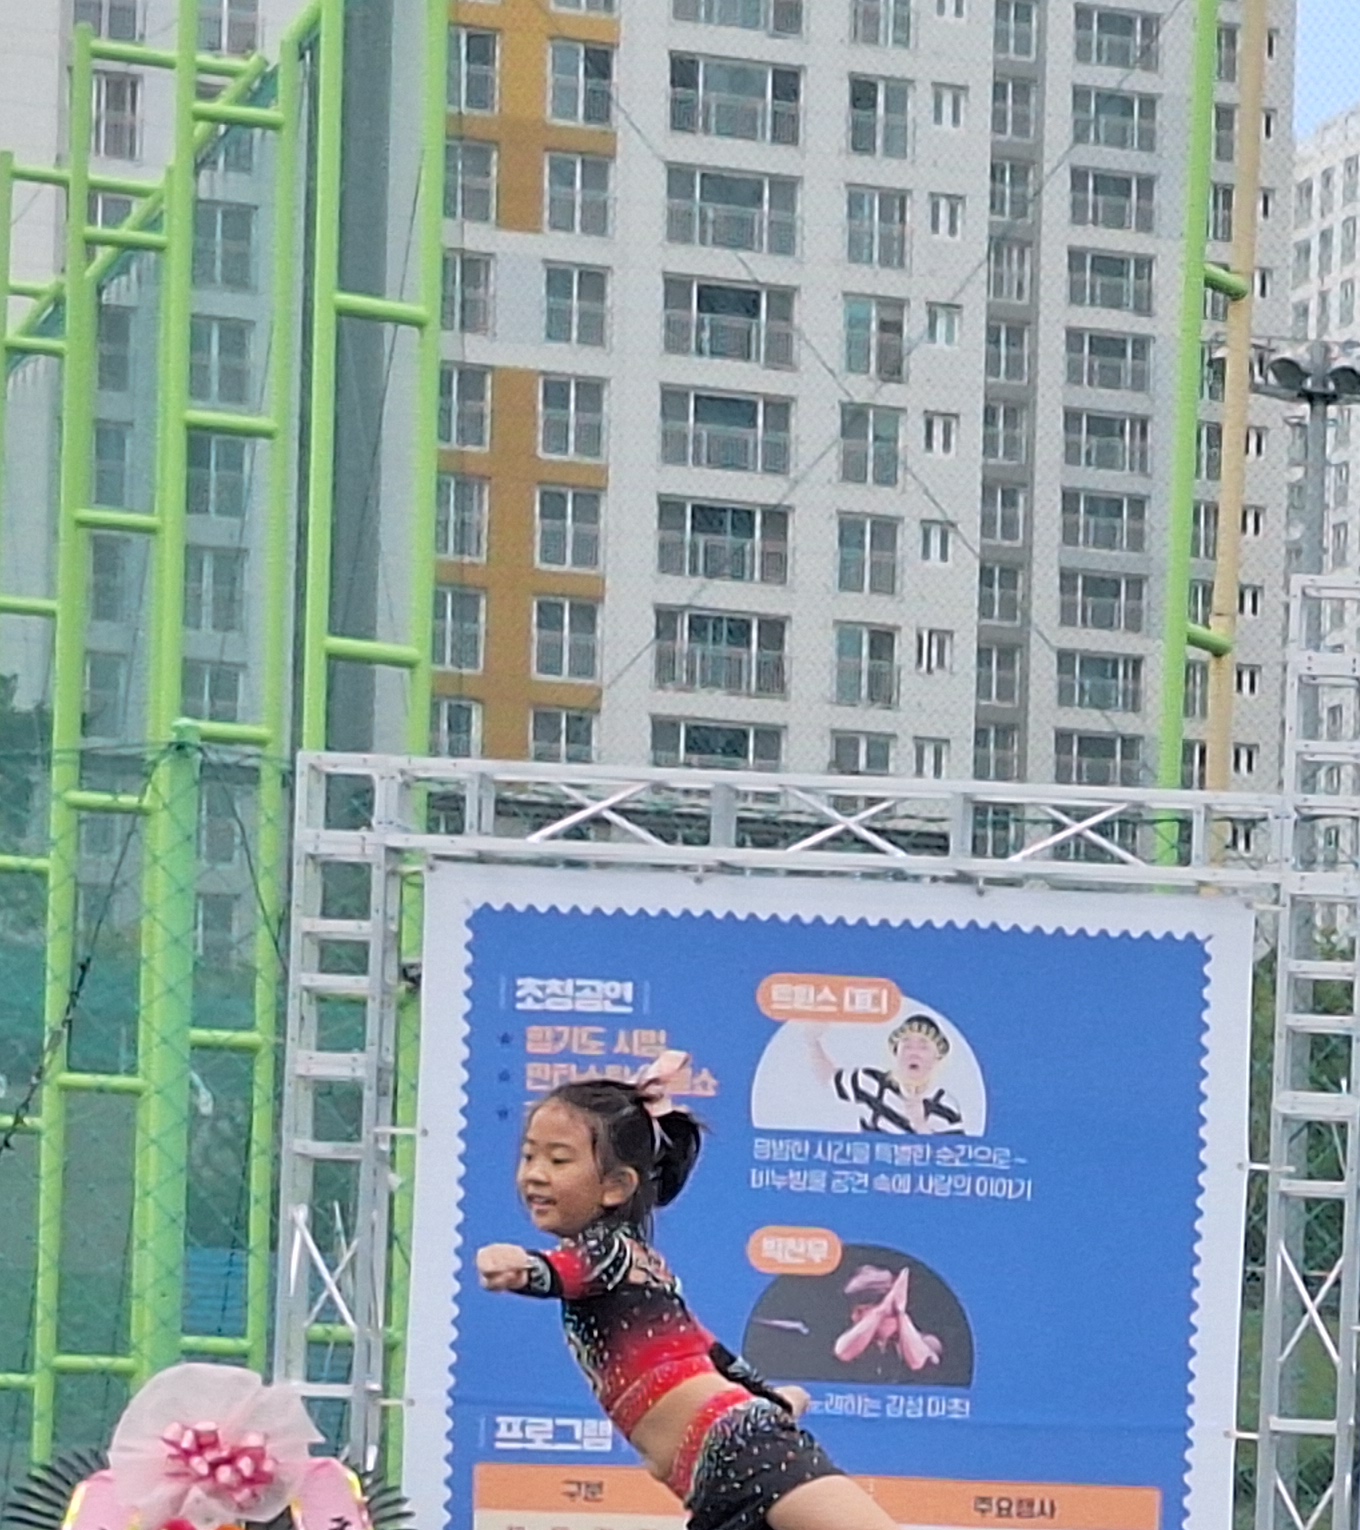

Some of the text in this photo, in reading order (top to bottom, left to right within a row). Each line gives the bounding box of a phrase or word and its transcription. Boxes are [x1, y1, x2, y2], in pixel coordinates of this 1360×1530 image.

[514, 979, 634, 1014] 초청공연
[830, 1169, 869, 1194] 공연
[494, 1415, 614, 1453] 프로그램
